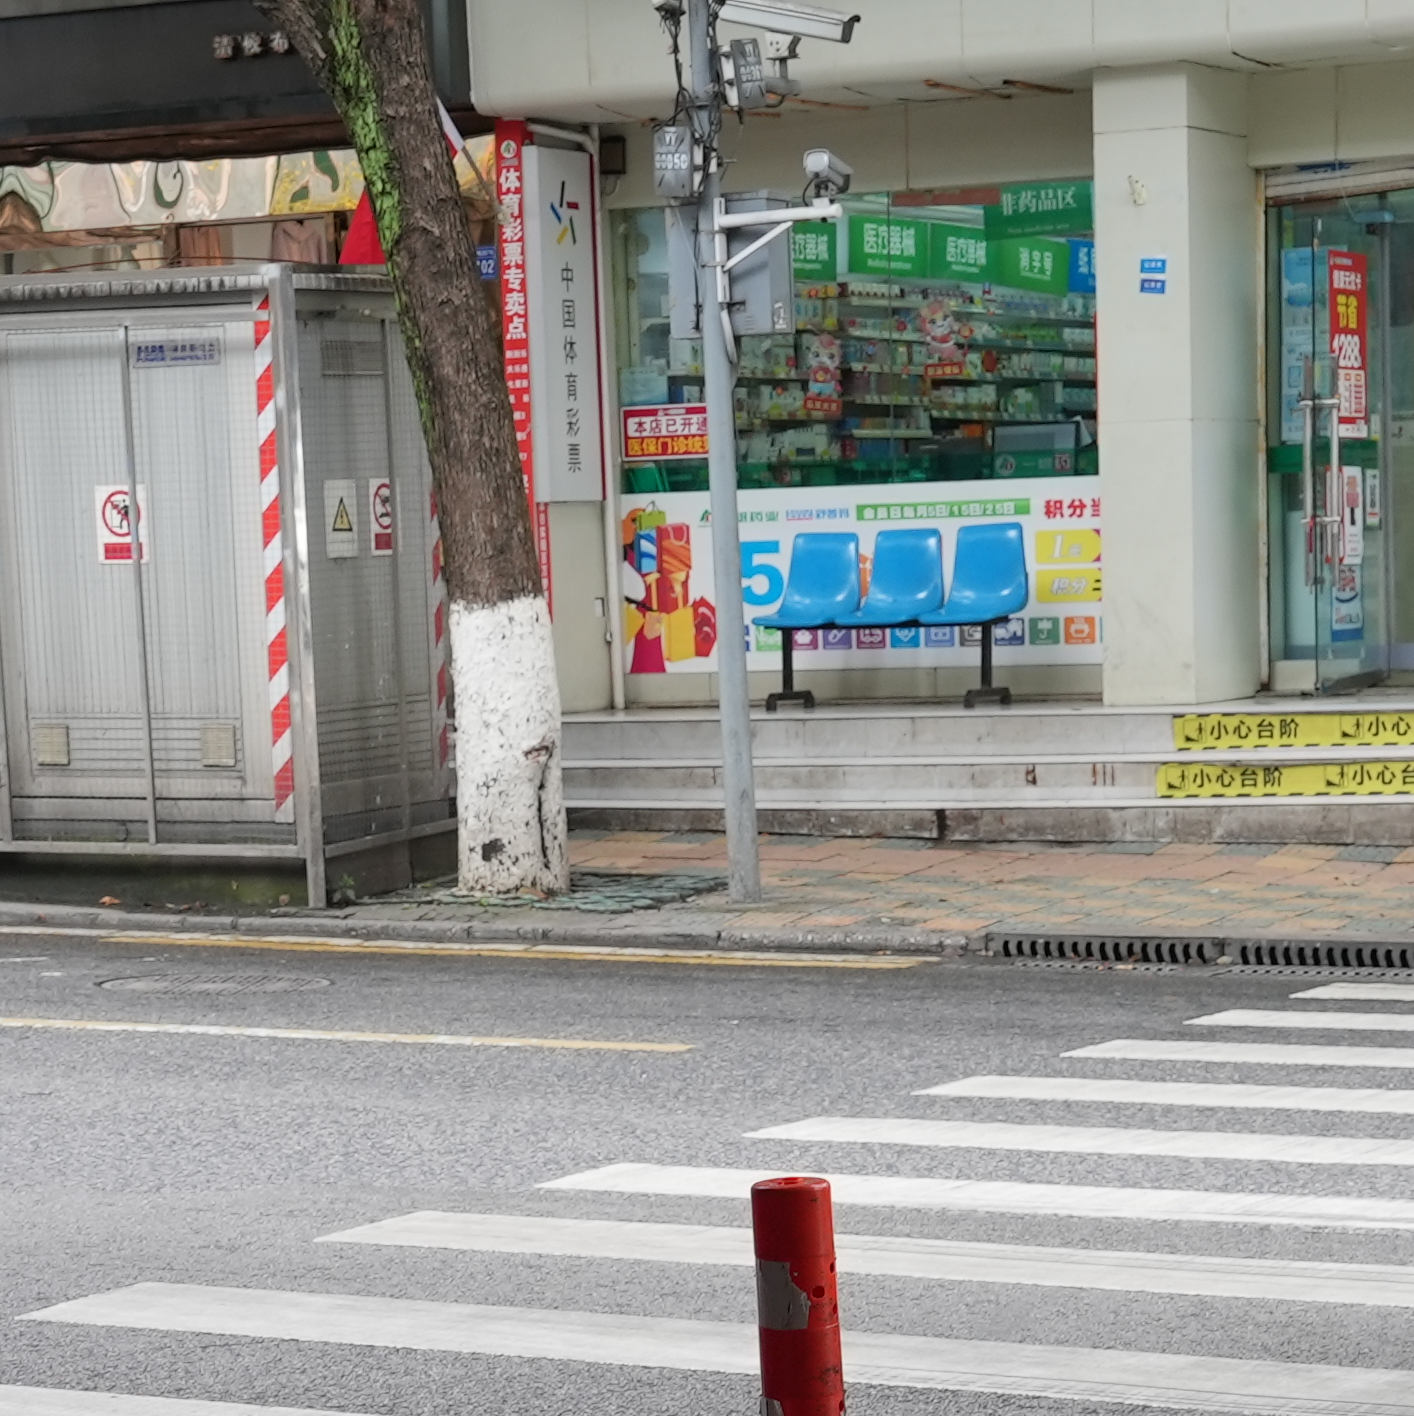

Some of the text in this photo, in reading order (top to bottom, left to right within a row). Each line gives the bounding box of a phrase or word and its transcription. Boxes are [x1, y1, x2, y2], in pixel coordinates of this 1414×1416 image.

[1001, 185, 1077, 217] 非药品区
[498, 168, 527, 341] 体育彩票专卖点
[791, 232, 829, 261] 疗器械
[863, 222, 917, 257] 医疗器械
[560, 261, 582, 474] 中国体育彩票
[1209, 718, 1300, 740] 小心台阶
[1192, 766, 1284, 789] 小心台阶
